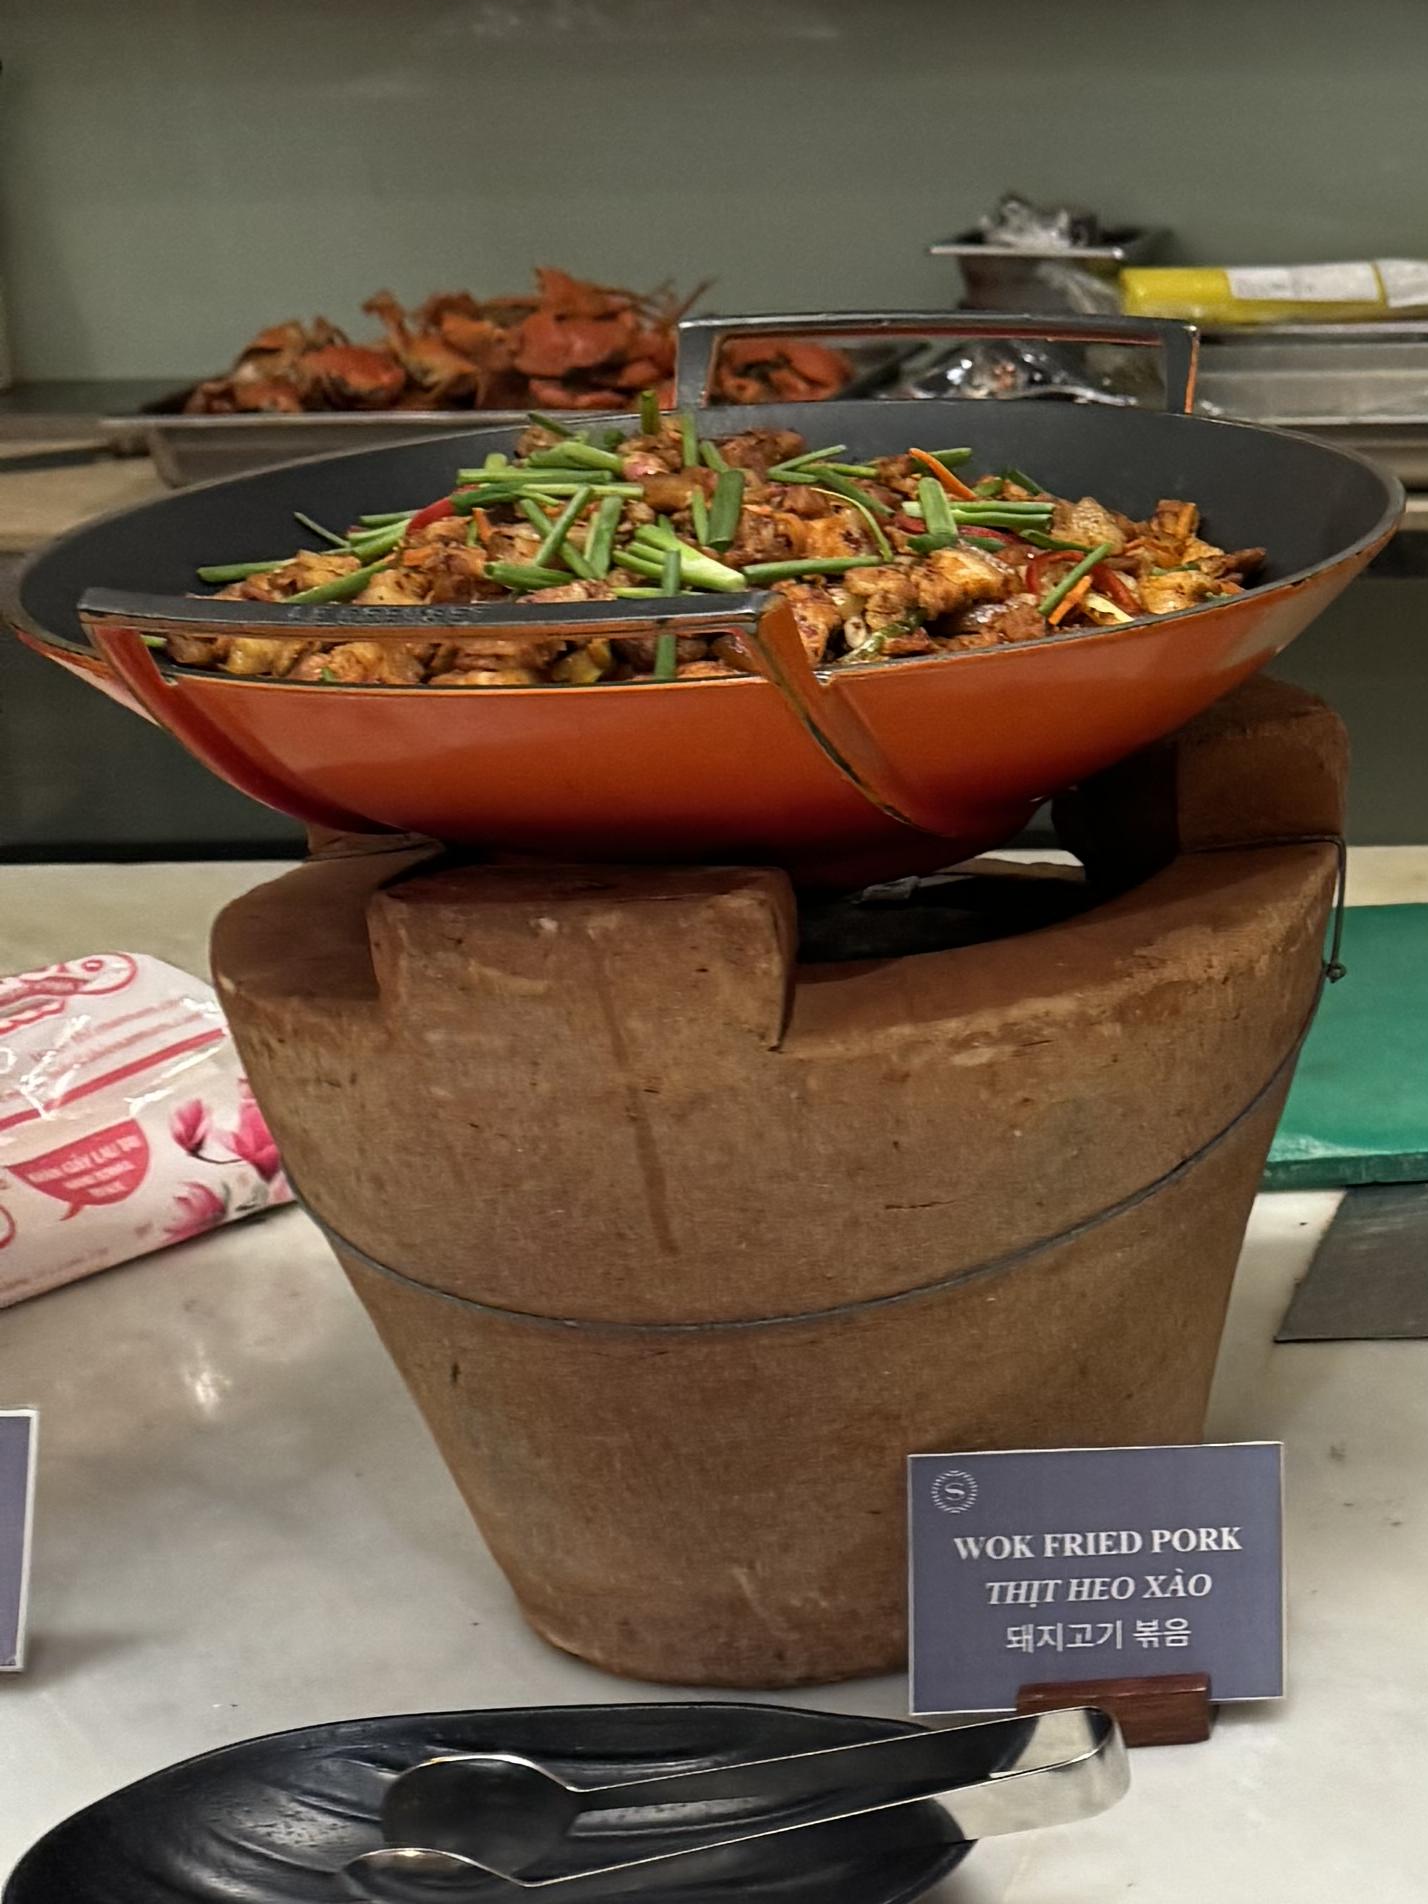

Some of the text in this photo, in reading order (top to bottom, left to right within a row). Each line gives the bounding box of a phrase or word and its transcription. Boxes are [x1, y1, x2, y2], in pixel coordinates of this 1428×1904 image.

[954, 1526, 1243, 1560] WOK FRIED PORK
[986, 1568, 1213, 1609] THỊT HEO XÀO
[1006, 1617, 1193, 1654] 돼지고기 볶음
